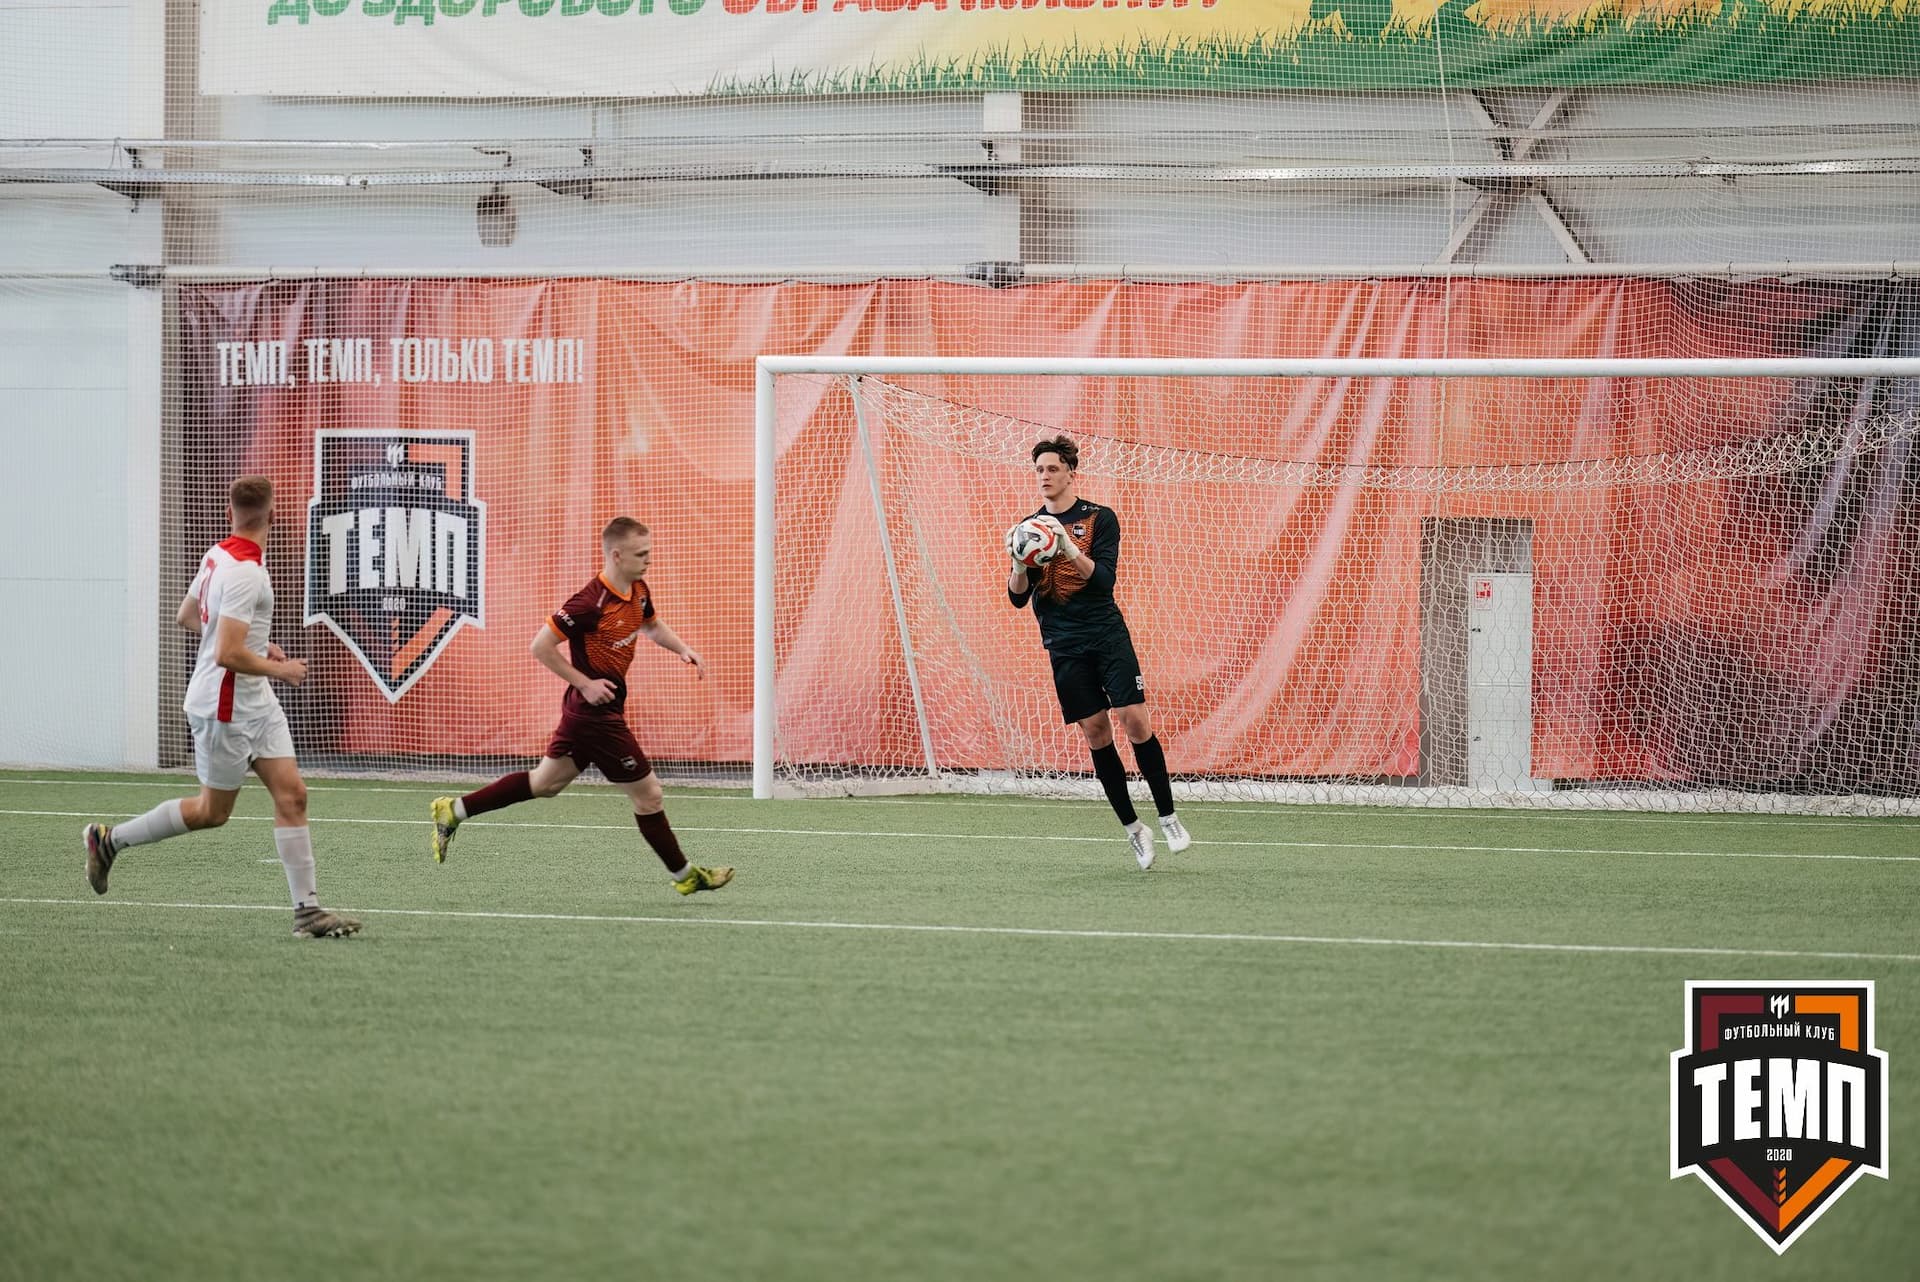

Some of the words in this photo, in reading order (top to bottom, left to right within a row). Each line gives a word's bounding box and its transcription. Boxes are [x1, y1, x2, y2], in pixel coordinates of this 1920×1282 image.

[217, 340, 296, 389] ТЕМП,
[304, 337, 381, 387] ТЕМП,
[390, 337, 494, 383] ТОЛЬКО
[503, 337, 584, 383] ТЕМП!
[420, 474, 442, 490] КЛУБ
[322, 507, 468, 598] ТЕМП
[383, 597, 406, 611] 2020
